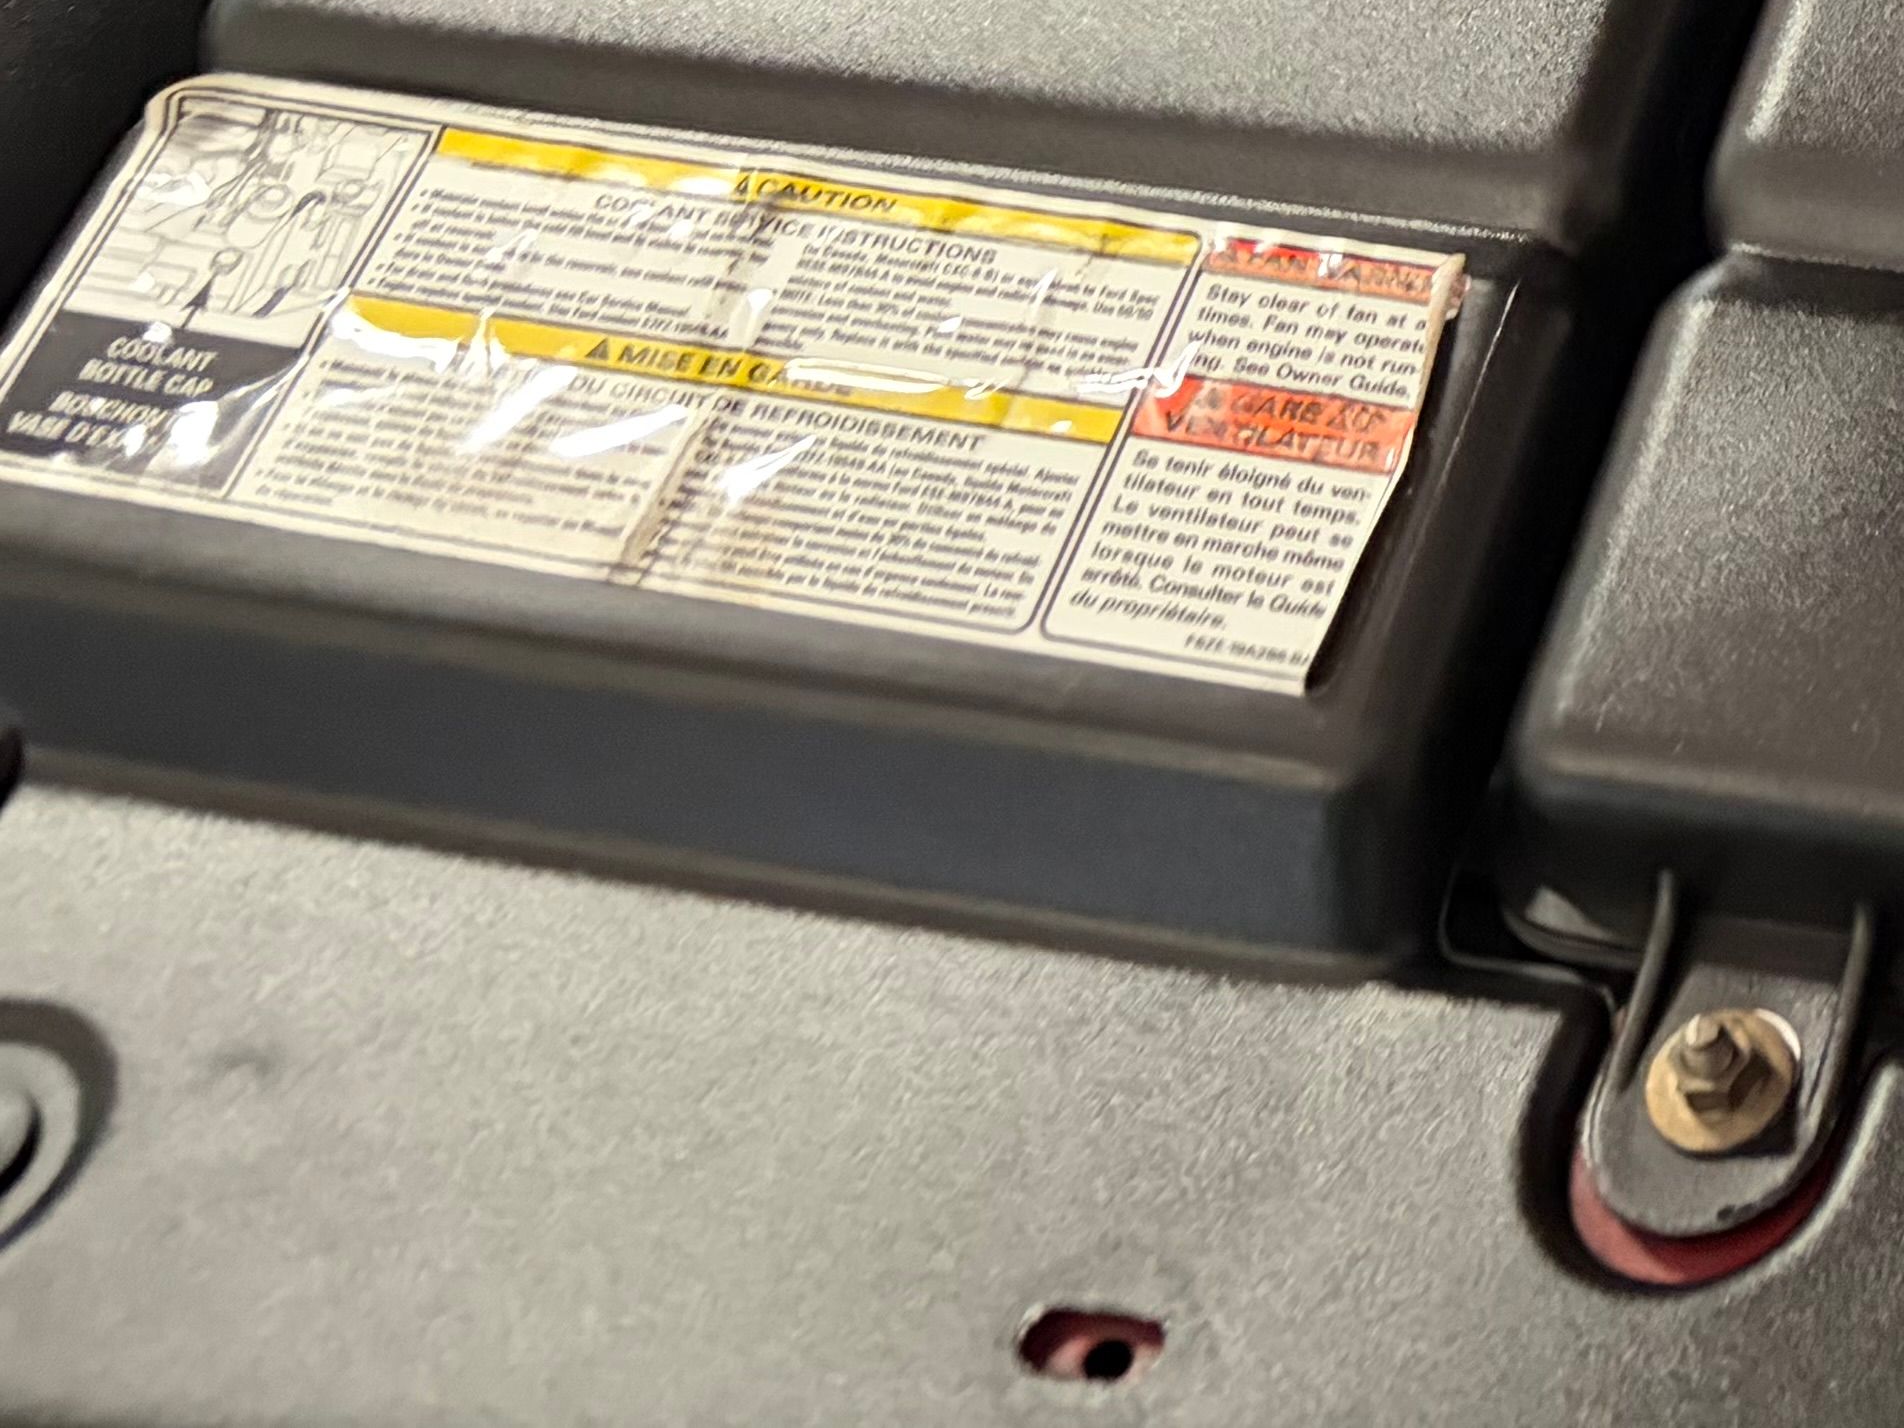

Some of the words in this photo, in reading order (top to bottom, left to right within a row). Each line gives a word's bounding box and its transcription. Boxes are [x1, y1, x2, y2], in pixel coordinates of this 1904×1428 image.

[752, 176, 900, 216] CAUTION
[1092, 298, 1117, 314] Use
[1098, 283, 1129, 300] Ford
[1203, 282, 1254, 309] Stay
[1255, 290, 1312, 315] clear
[1314, 299, 1341, 319] of
[1344, 303, 1380, 325] fan
[1385, 310, 1409, 329] at
[1195, 305, 1258, 328] times.
[1261, 313, 1302, 335] Fan
[1303, 325, 1348, 345] may
[102, 334, 220, 373] COOLANT
[616, 342, 696, 372] MISE
[698, 353, 744, 379] EN
[1185, 327, 1243, 350] when
[1243, 336, 1315, 364] engine
[1316, 345, 1337, 364] is
[1338, 350, 1377, 370] not
[76, 357, 169, 391] BOTTLE
[161, 372, 215, 399] CAP
[1231, 355, 1273, 377] See
[1274, 361, 1345, 387] Owner
[4, 409, 72, 440] VASE
[566, 373, 607, 396] DU
[710, 394, 748, 417] DE
[749, 400, 985, 452] REFROIDISSEMENT
[1130, 447, 1162, 471] Se
[1163, 453, 1215, 478] tenir
[1215, 461, 1294, 494] éloigné
[1295, 474, 1326, 495] du
[1110, 492, 1142, 516] Le
[1145, 498, 1267, 535] ventilateur
[1268, 520, 1322, 547] peut
[1327, 532, 1355, 549] se
[1122, 470, 1203, 500] tilateur
[1205, 487, 1234, 505] en
[1239, 490, 1286, 514] tout
[1290, 498, 1366, 529] temps.
[1099, 517, 1173, 545] mettre
[1171, 531, 1200, 549] en
[1199, 532, 1282, 564] marche
[1280, 544, 1348, 574] même
[1087, 539, 1177, 577] lorsque
[1181, 553, 1207, 576] le
[1209, 560, 1296, 590] moteur
[1298, 575, 1336, 596] est
[1068, 586, 1101, 609] du
[1096, 590, 1232, 634] propriétaire.
[1080, 562, 1148, 590] arrêté.
[1146, 572, 1247, 607] Consulter
[1245, 588, 1268, 609] le
[1266, 592, 1329, 620] Guide
